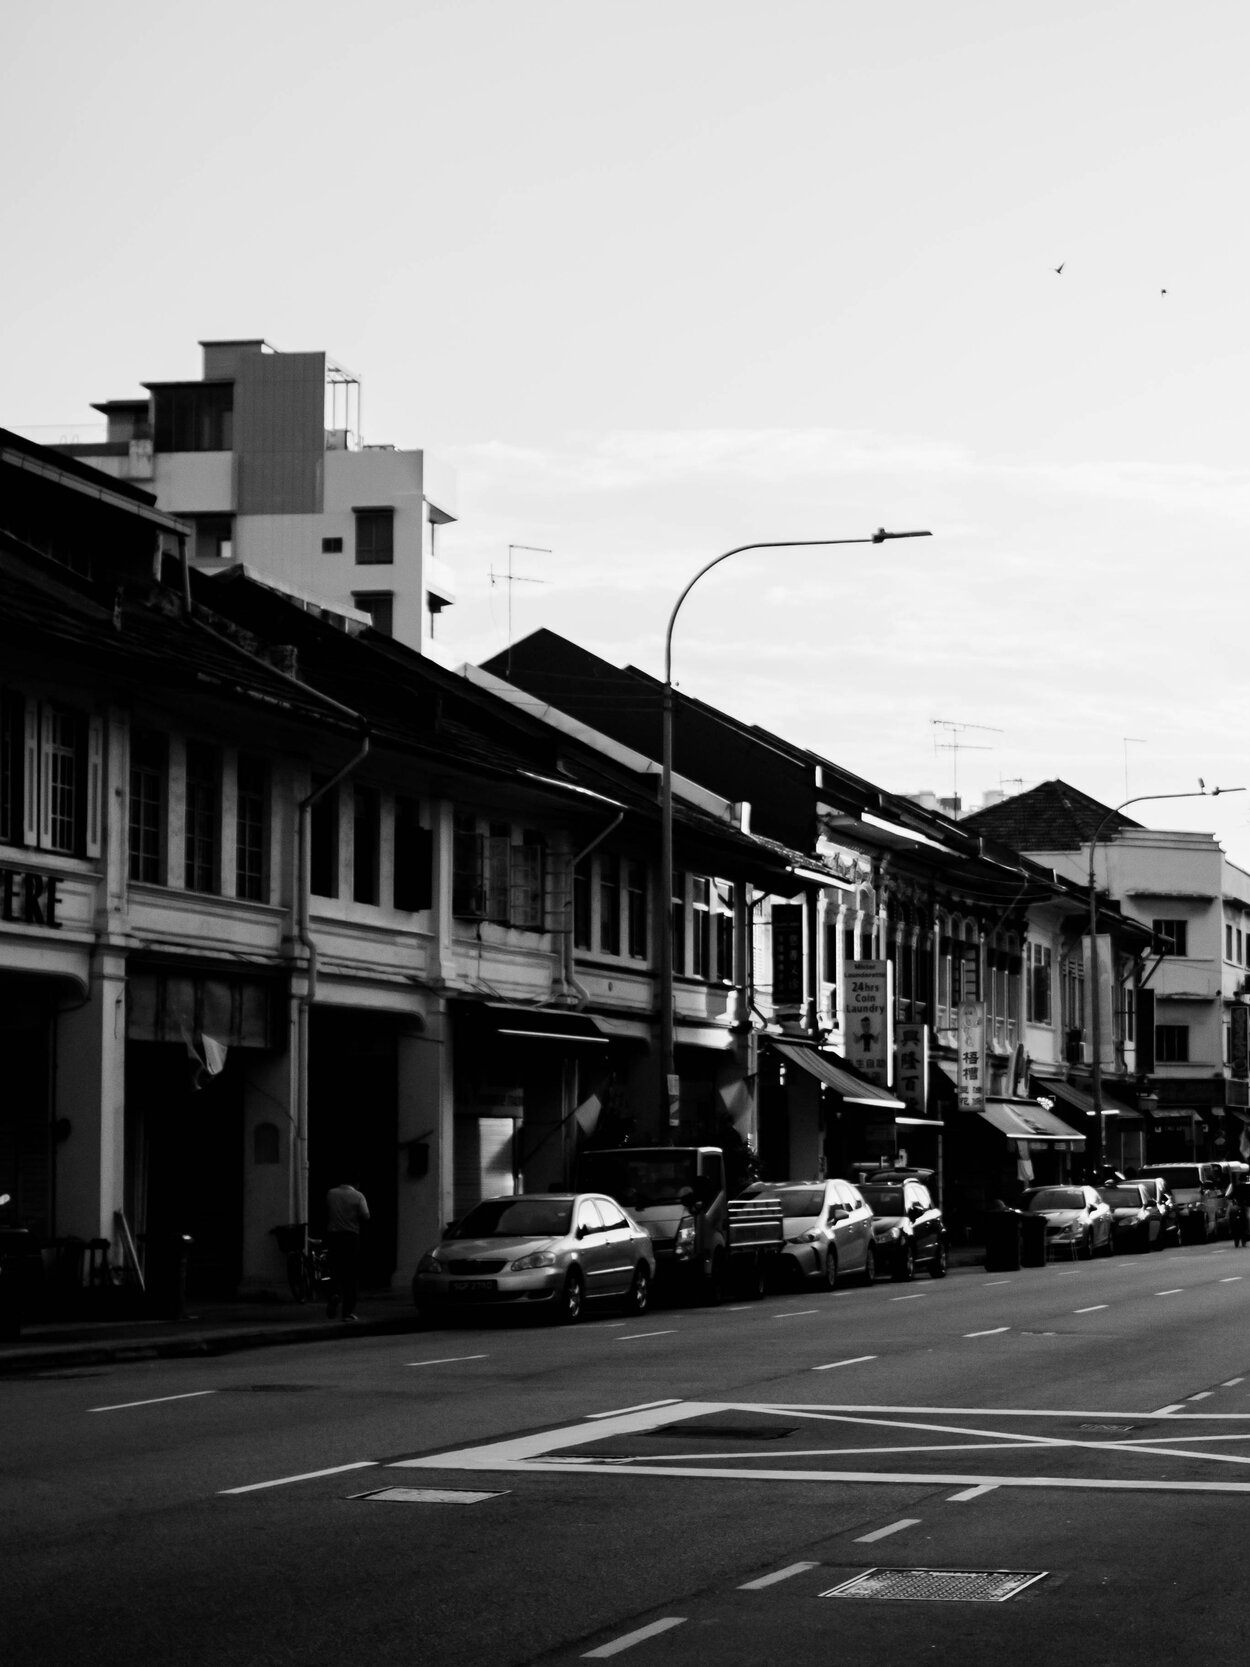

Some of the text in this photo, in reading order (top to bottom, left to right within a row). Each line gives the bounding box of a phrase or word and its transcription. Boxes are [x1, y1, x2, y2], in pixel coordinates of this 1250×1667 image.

[0, 868, 64, 929] ERE
[852, 981, 880, 992] 24hrs
[855, 993, 877, 1002] Coin
[846, 1003, 885, 1015] Laundry
